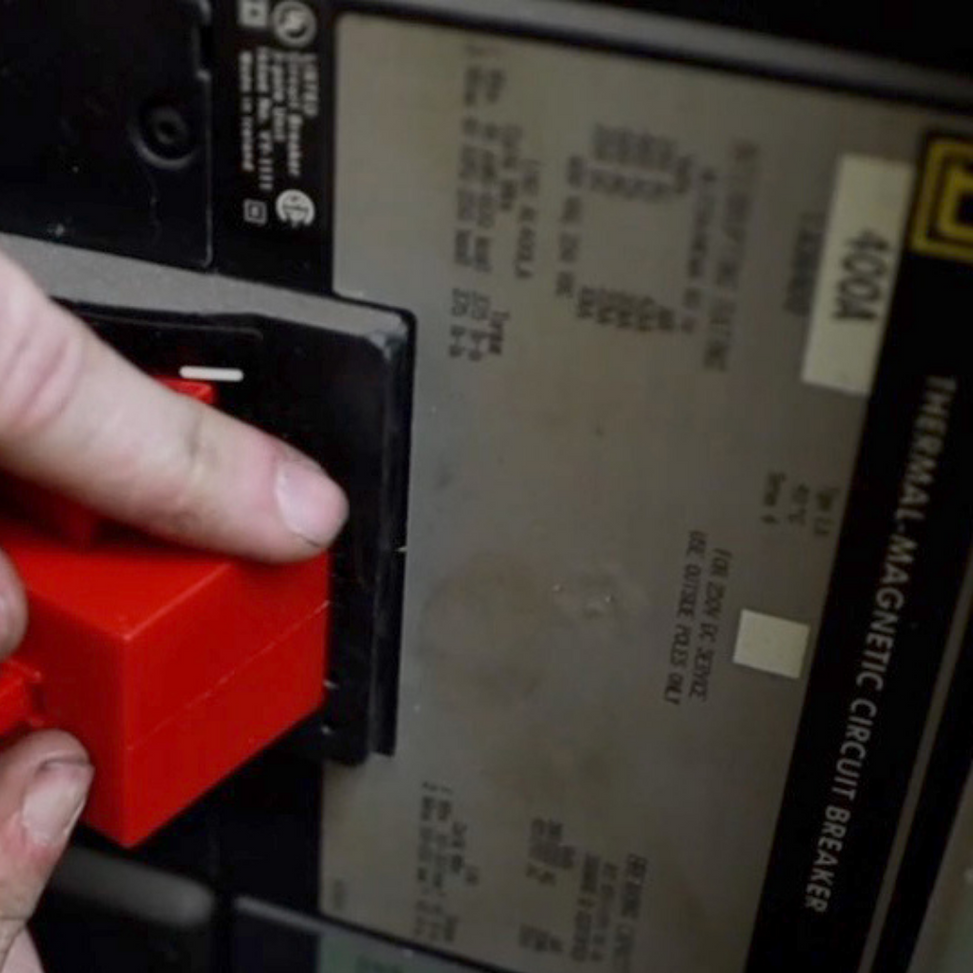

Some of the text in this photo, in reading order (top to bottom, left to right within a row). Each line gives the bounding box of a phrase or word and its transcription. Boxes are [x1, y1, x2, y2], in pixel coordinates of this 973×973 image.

[831, 231, 890, 321] 400A
[664, 530, 709, 706] USE OUTSIDE POLES ONLY
[689, 548, 733, 703] FOR 250V DC SERVICE
[804, 376, 957, 913] THERMAL-MAGNETIC CIRCUIT BREAKER
